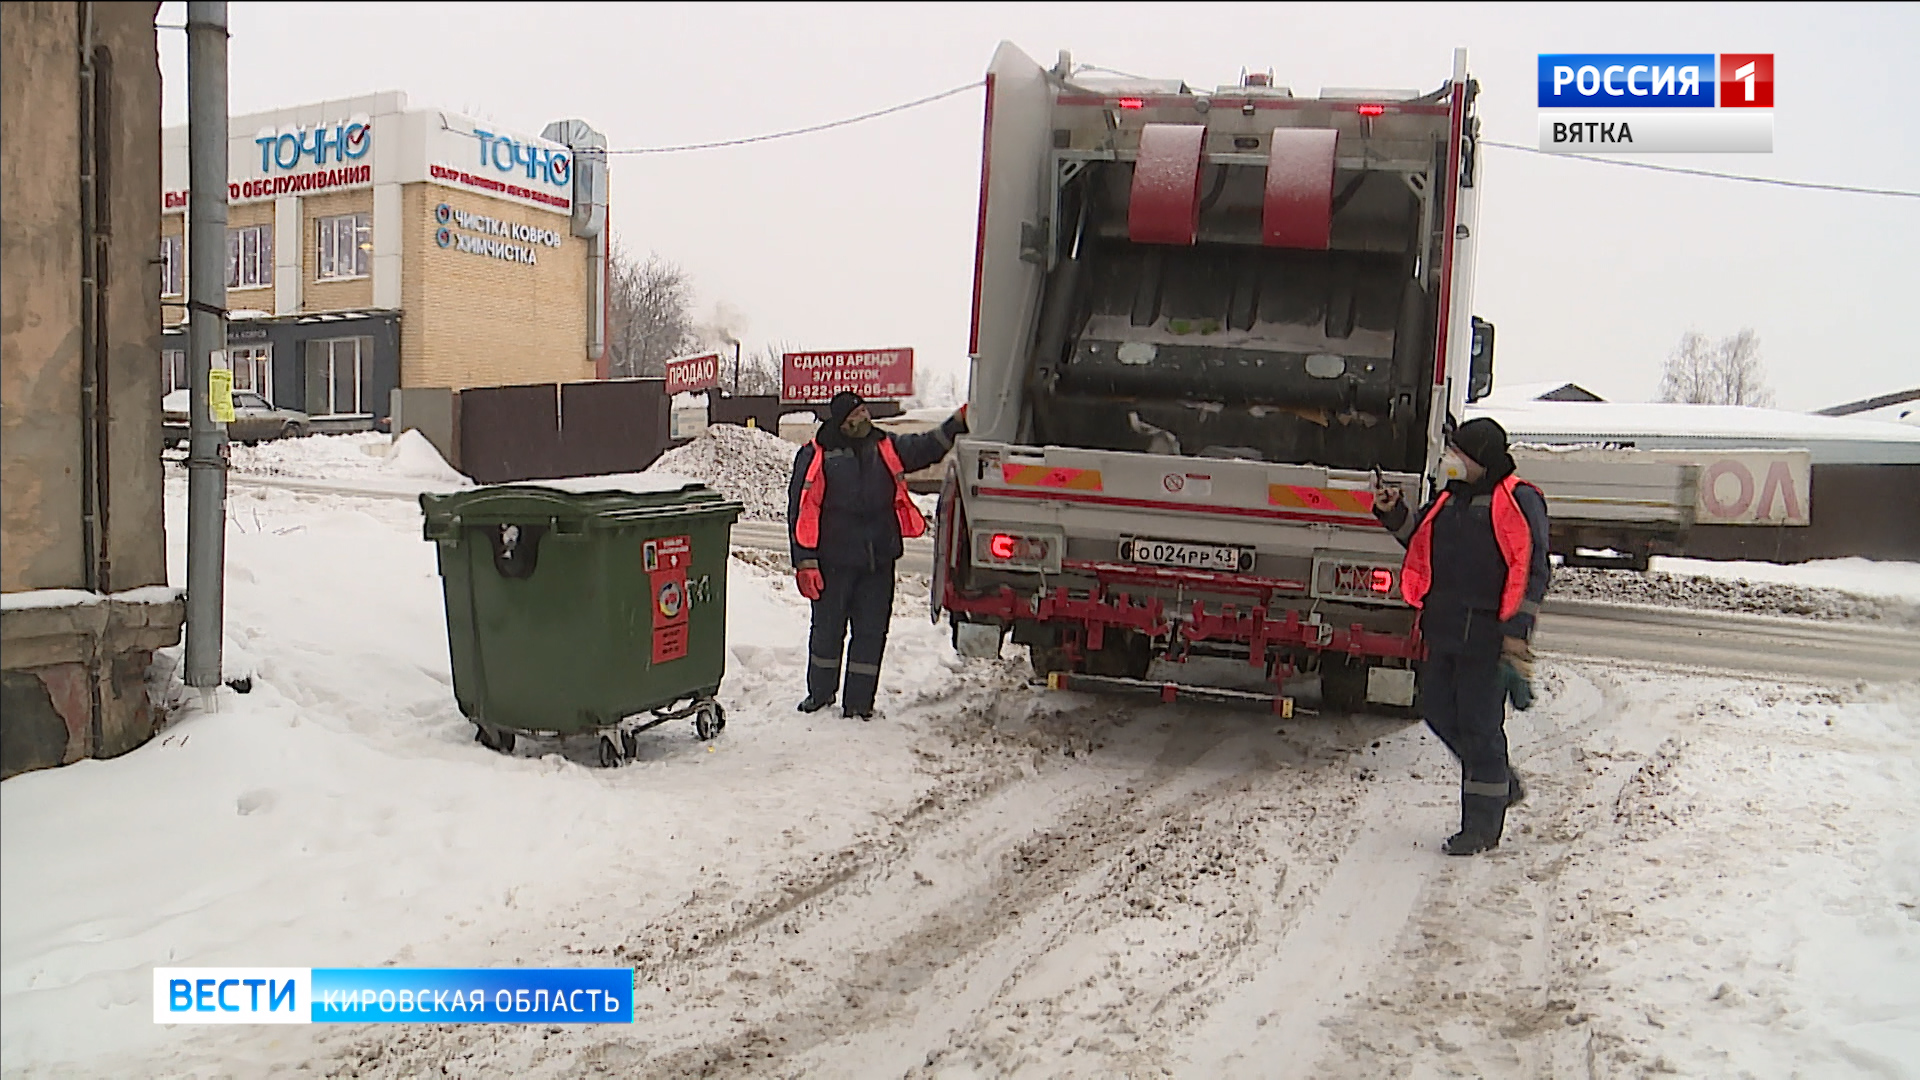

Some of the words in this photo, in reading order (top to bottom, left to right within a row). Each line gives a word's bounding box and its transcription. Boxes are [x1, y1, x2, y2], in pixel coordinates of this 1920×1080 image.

[256, 123, 371, 172] ТОЧНО
[473, 129, 570, 186] ТОЧНО
[243, 165, 371, 198] ОБСЛУЖИВАНИЯ
[454, 210, 507, 238] ЧИСТКА
[511, 222, 561, 248] КОВРОВ
[456, 233, 537, 265] ХИМЧИСТКА
[669, 362, 714, 386] ПРОДАЮ
[793, 355, 833, 370] СДАЮ
[836, 355, 844, 366] В
[846, 353, 899, 367] АРЕНДУ
[843, 369, 880, 380] СОТОК
